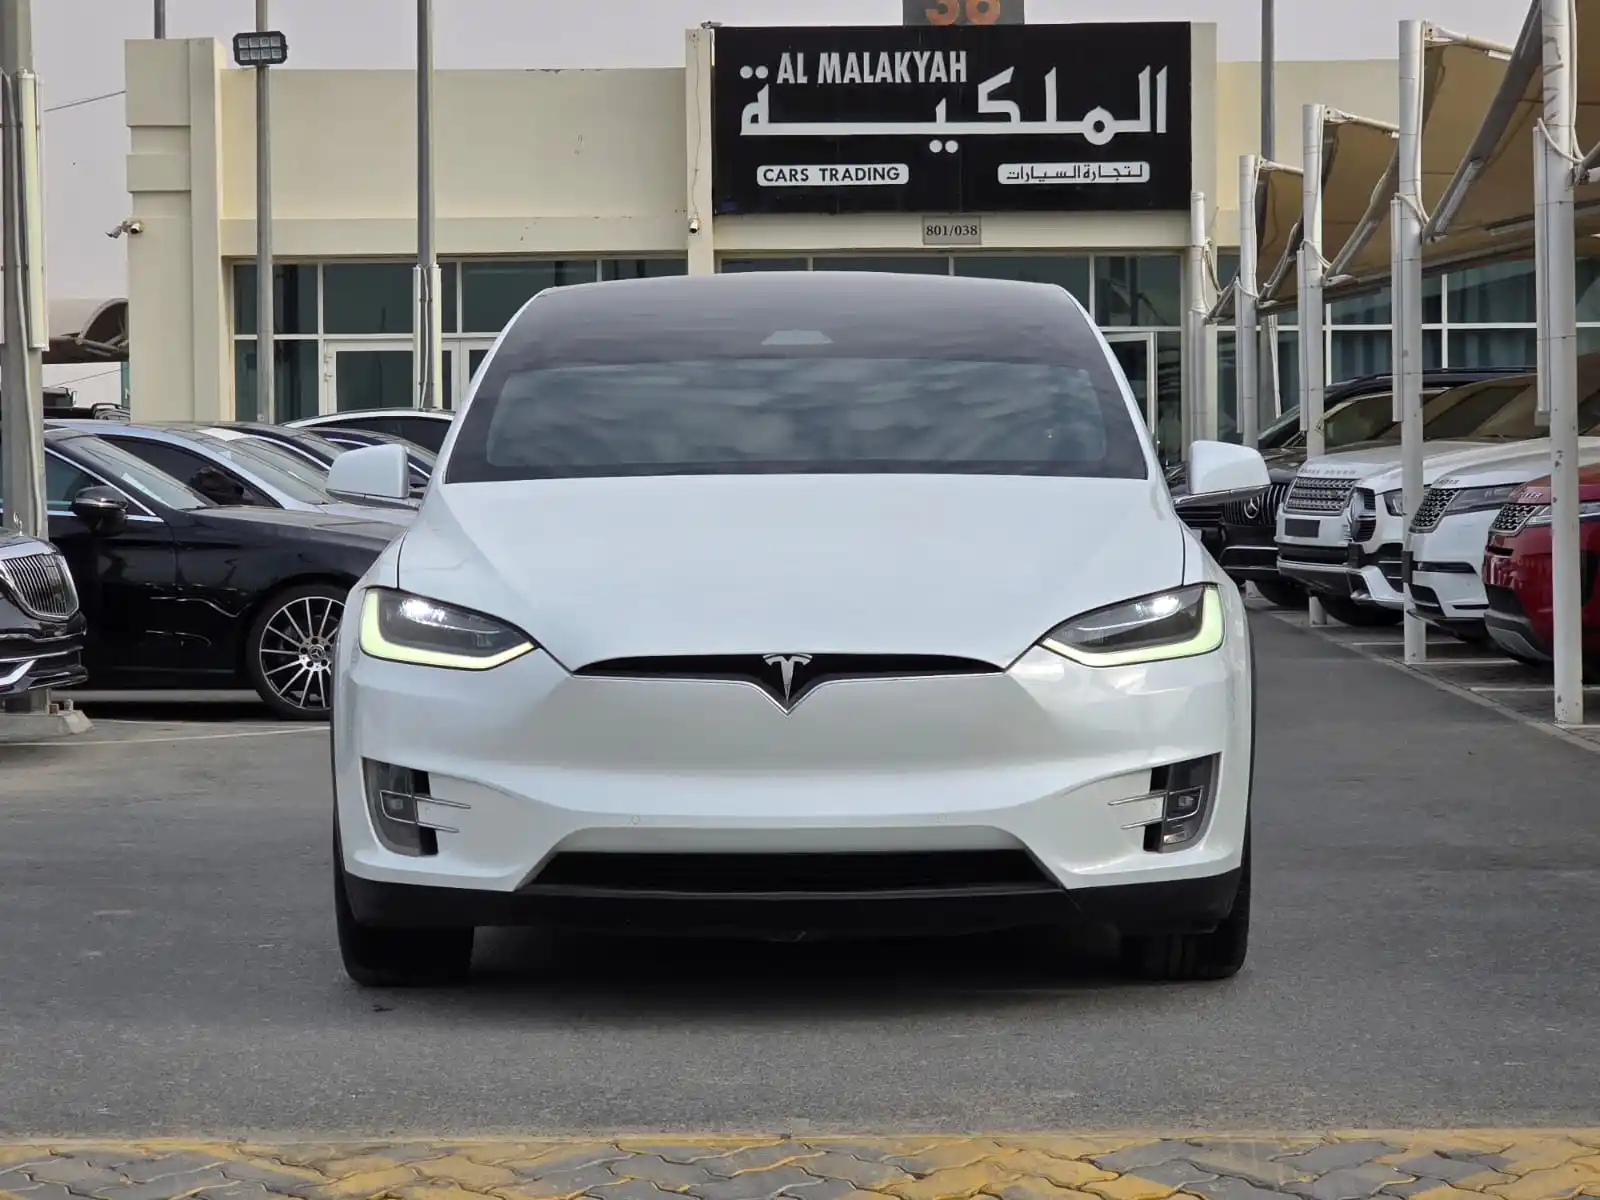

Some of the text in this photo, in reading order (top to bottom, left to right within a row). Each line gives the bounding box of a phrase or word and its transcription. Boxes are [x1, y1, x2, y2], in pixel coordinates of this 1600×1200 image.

[776, 50, 967, 84] AL MALAKYAH
[740, 65, 1168, 153] الملكية
[763, 166, 901, 182] CARS TRADING
[1006, 164, 1143, 182] لتجارة السيارات
[926, 224, 978, 236] 801/038
